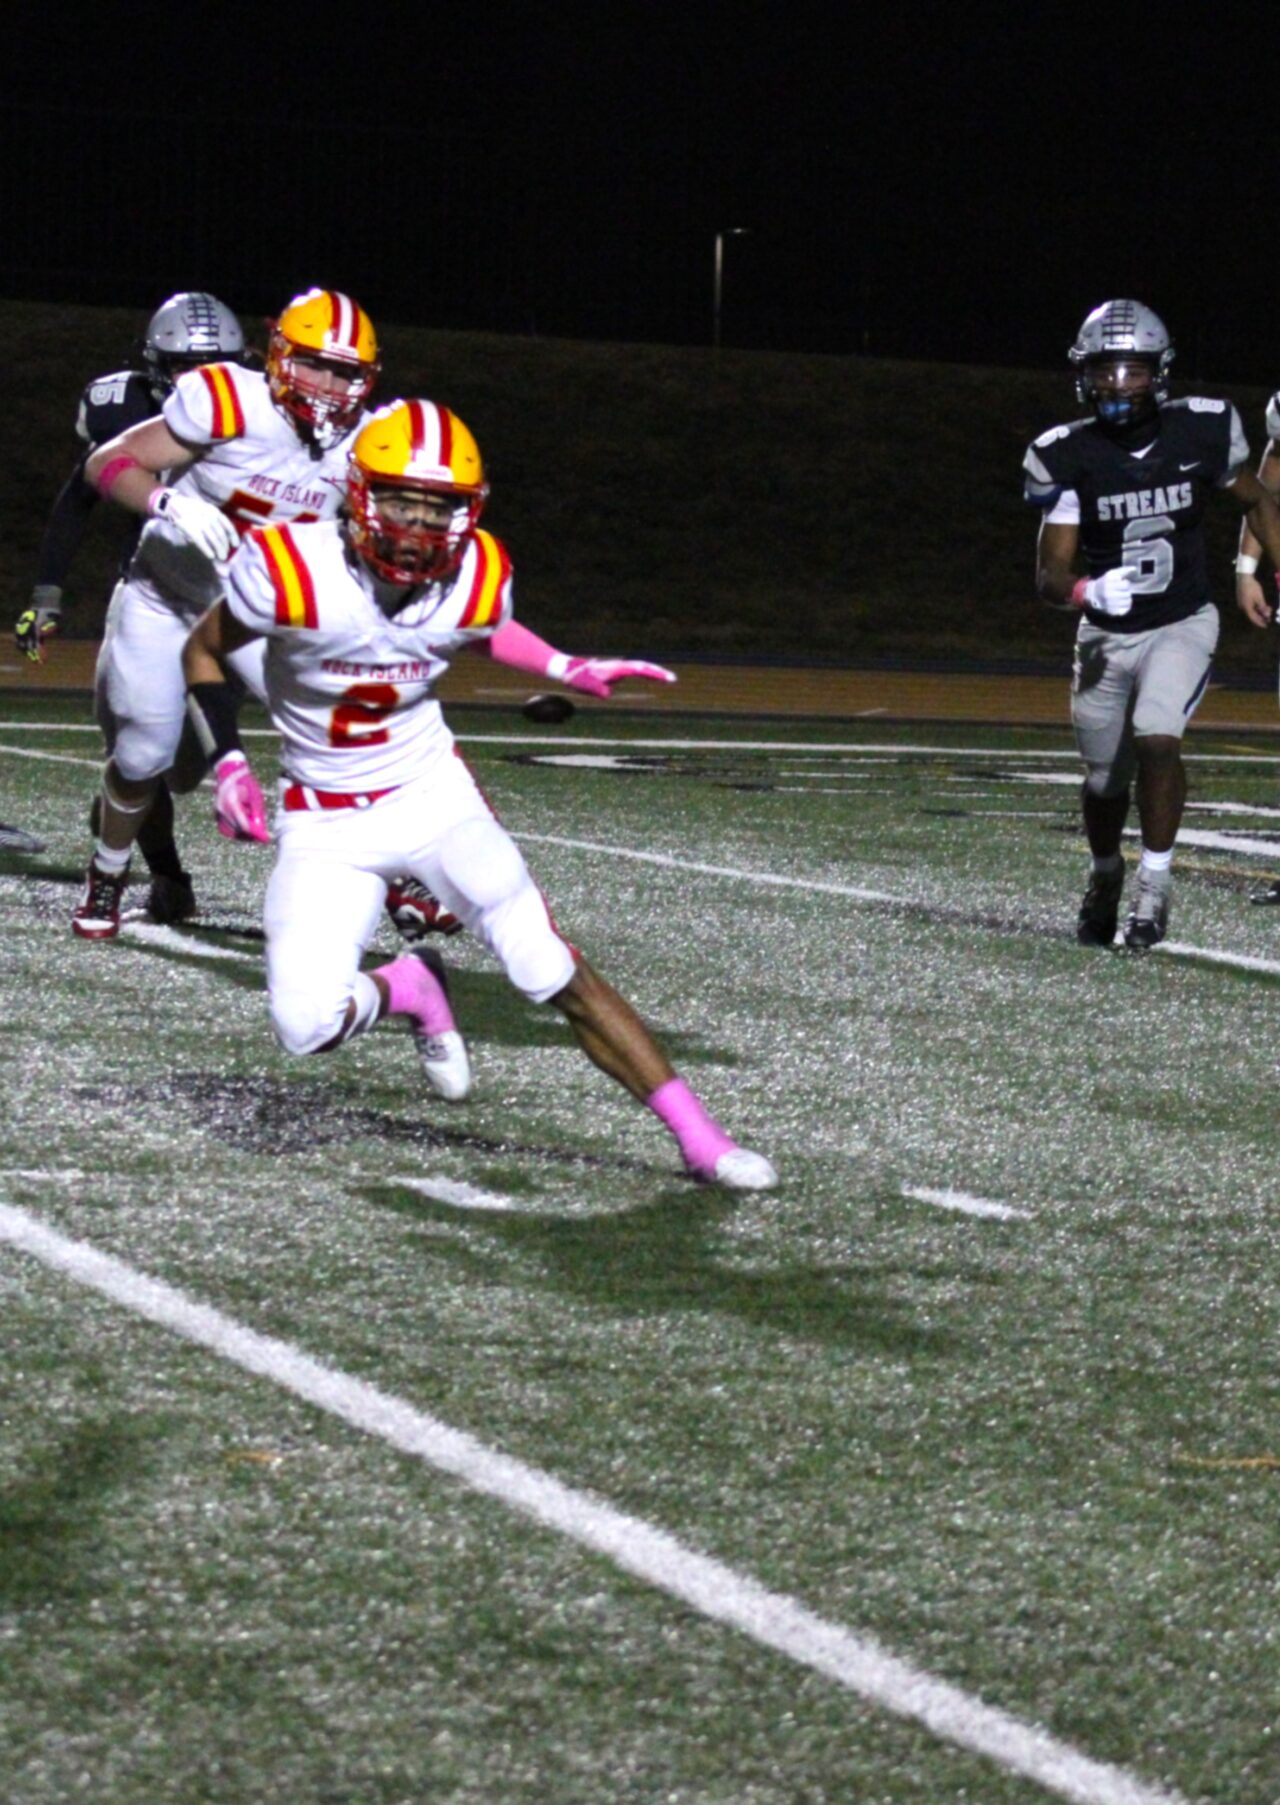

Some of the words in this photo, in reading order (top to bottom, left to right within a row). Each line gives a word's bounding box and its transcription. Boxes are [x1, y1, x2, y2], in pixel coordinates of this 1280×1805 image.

[1097, 481, 1193, 521] STREAKS
[1121, 515, 1175, 594] 6
[328, 683, 401, 749] 2
